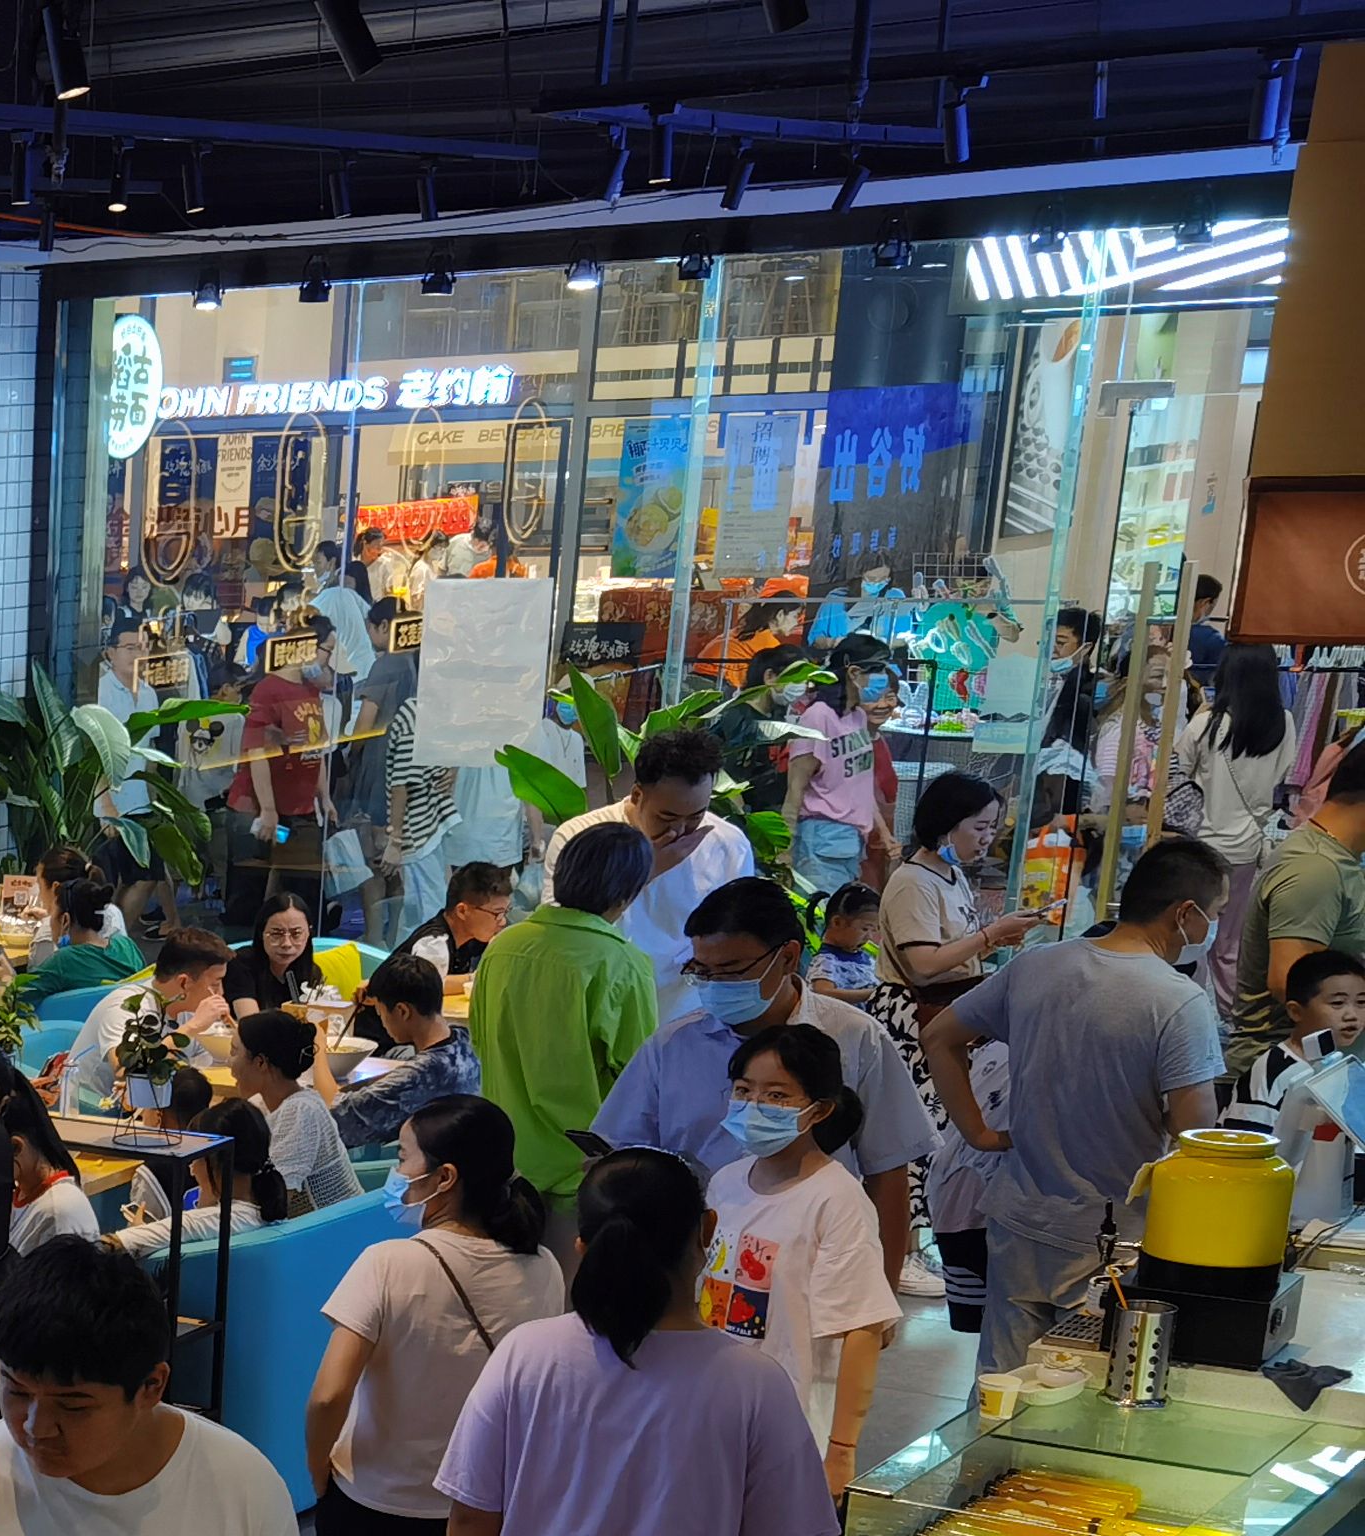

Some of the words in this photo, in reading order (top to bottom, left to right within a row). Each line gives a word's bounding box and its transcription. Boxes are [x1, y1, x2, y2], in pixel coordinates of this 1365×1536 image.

[156, 384, 234, 420] OHN
[235, 376, 389, 416] FRIENDS
[416, 429, 465, 446] CAKE
